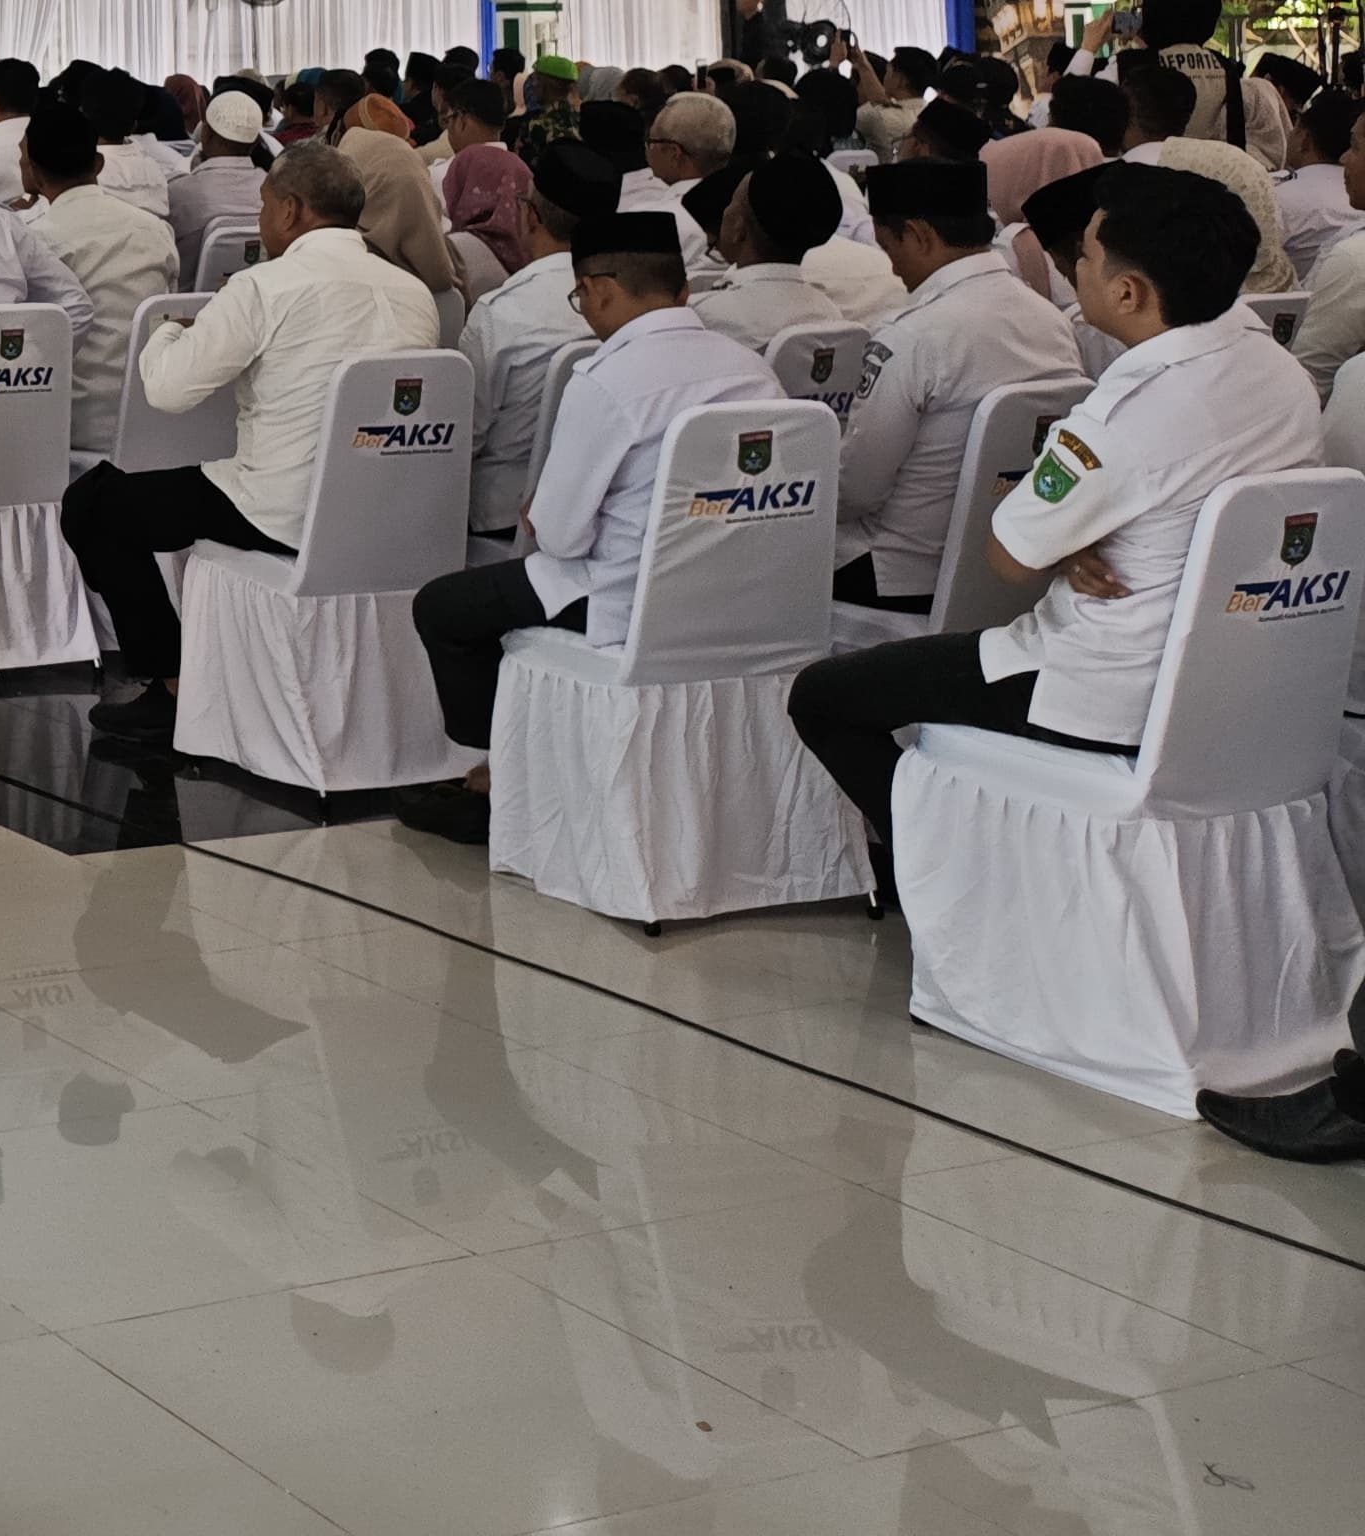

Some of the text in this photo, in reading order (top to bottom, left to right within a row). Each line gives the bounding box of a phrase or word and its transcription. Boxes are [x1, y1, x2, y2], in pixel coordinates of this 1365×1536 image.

[352, 423, 456, 448] BerAKSI
[687, 479, 816, 517] BerAKSI
[1225, 570, 1351, 613] BerAKSI
